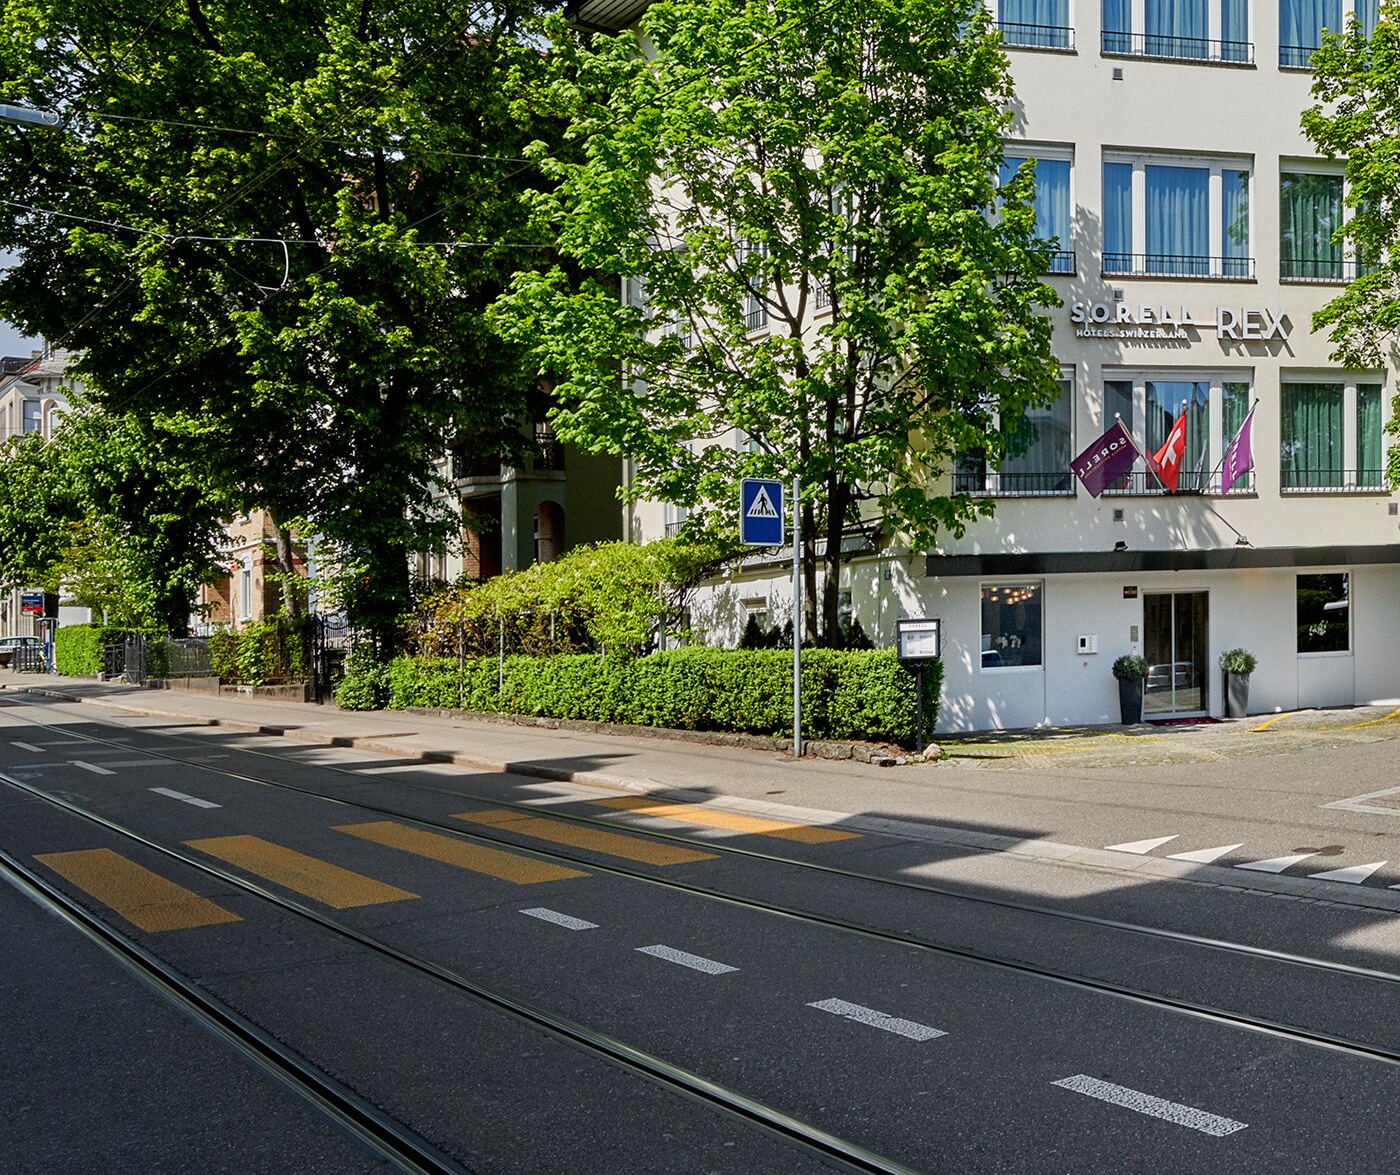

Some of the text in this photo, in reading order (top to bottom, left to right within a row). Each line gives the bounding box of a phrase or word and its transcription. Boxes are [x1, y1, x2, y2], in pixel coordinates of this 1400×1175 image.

[1071, 303, 1289, 340] SORELL REX
[1076, 329, 1188, 340] HOTELS SWITZERLAND
